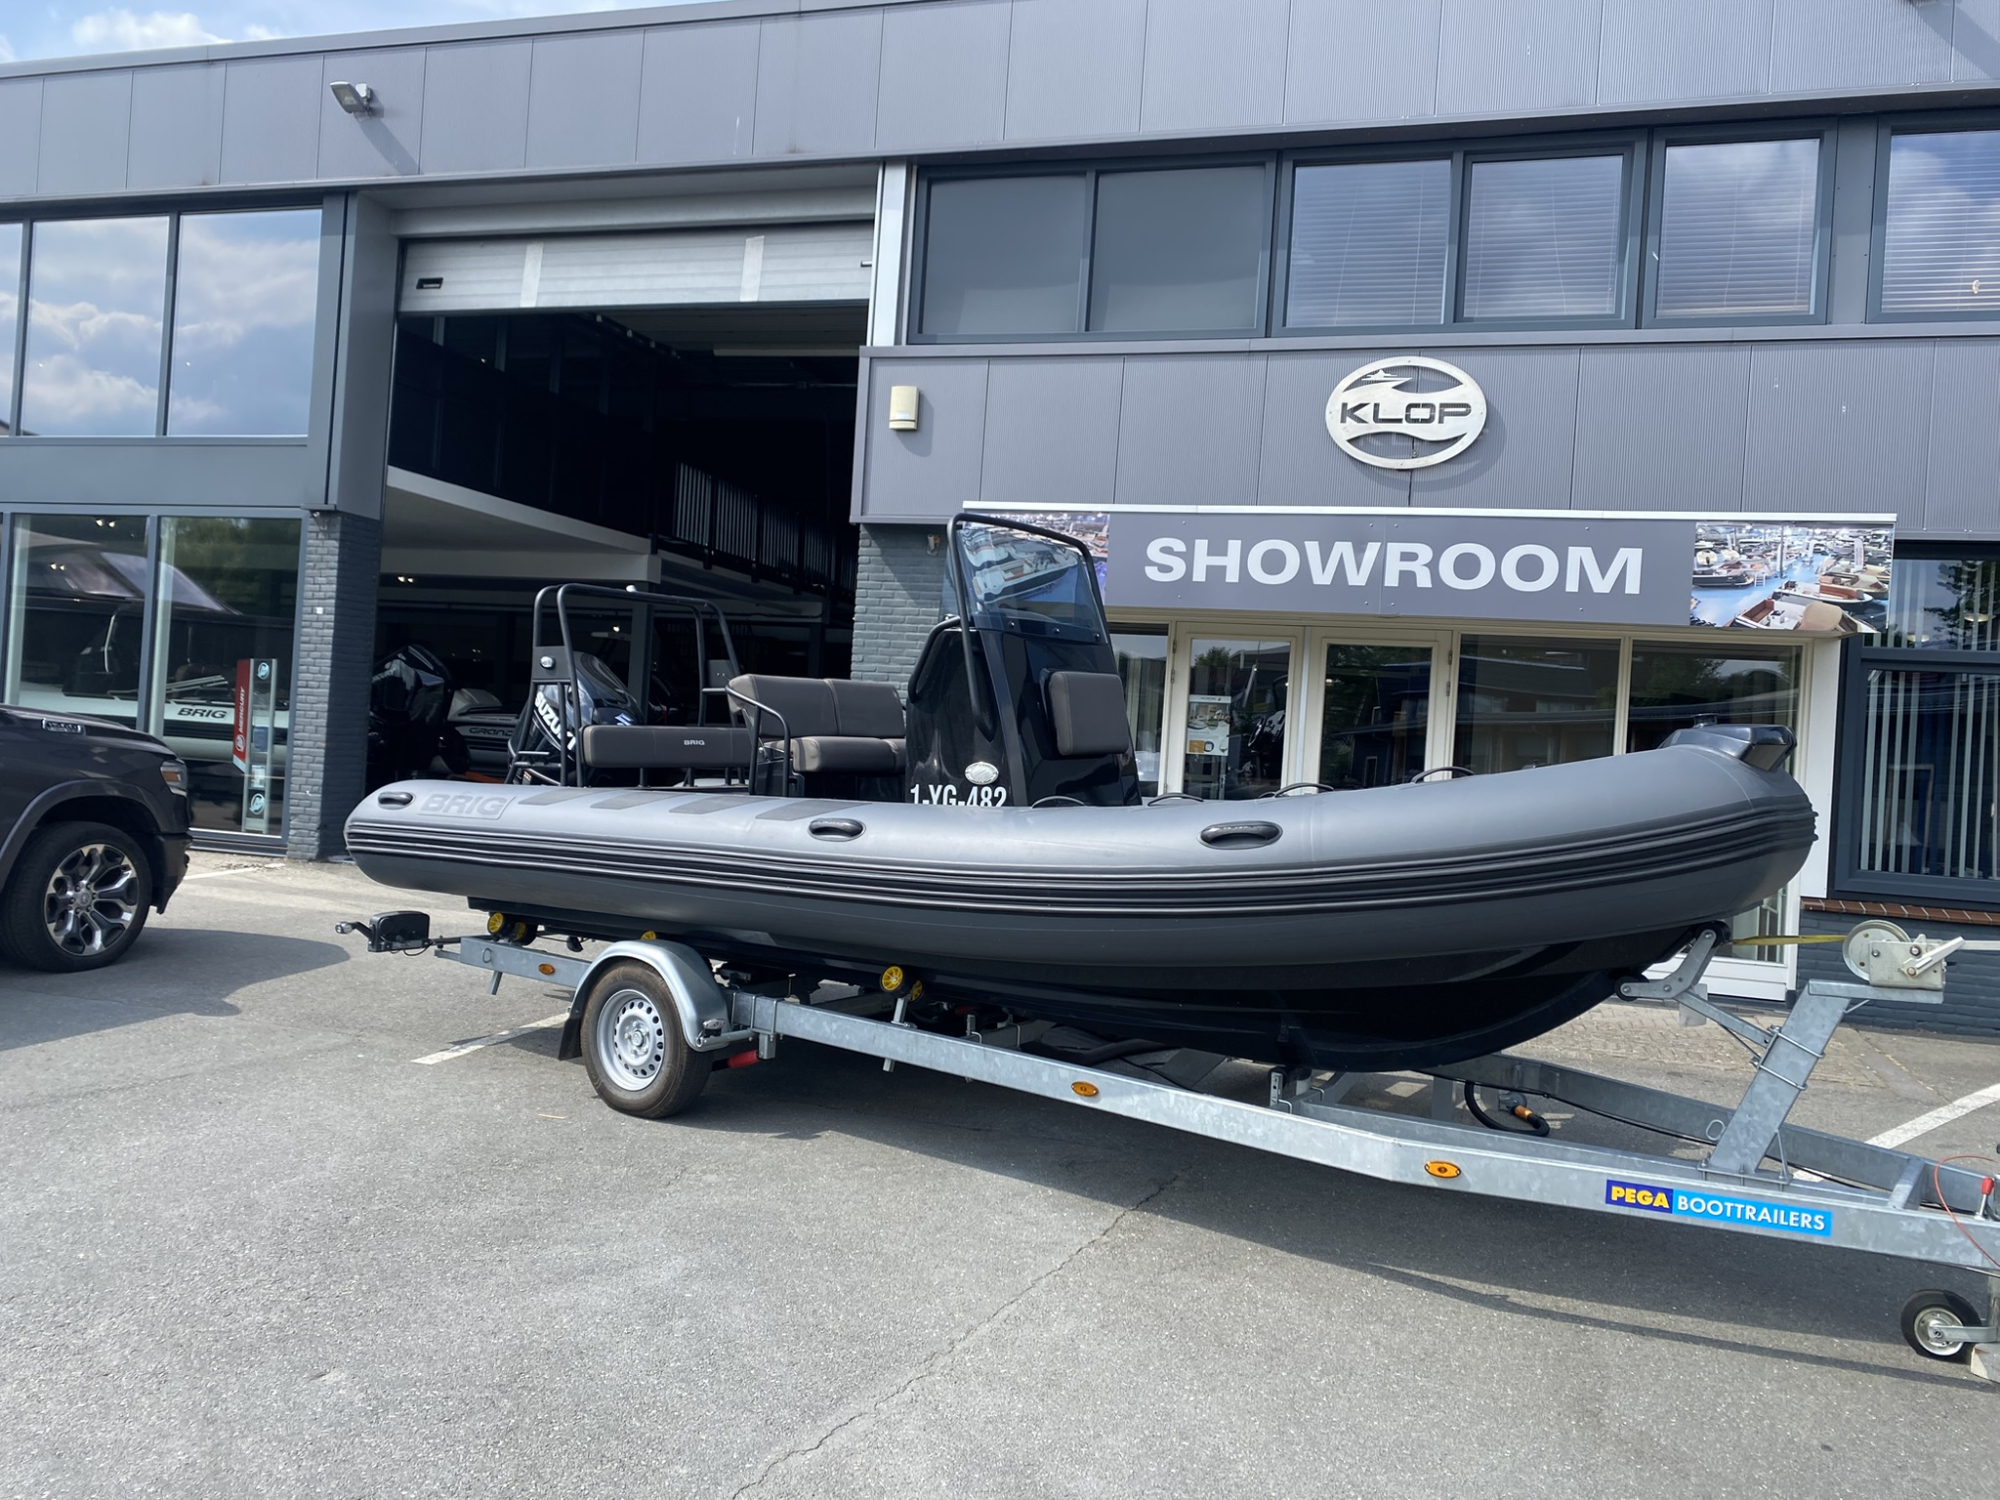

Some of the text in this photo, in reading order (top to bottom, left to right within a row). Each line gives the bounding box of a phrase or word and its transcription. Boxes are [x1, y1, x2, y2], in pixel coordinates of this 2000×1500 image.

[1340, 402, 1472, 424] KLOP
[1144, 537, 1644, 595] SHOWROOM
[177, 707, 227, 719] BRIG
[420, 793, 508, 815] BRIG
[910, 783, 1007, 807] 1-YG-482
[1611, 1186, 1825, 1231] PEGA BOOTTRAILERS
